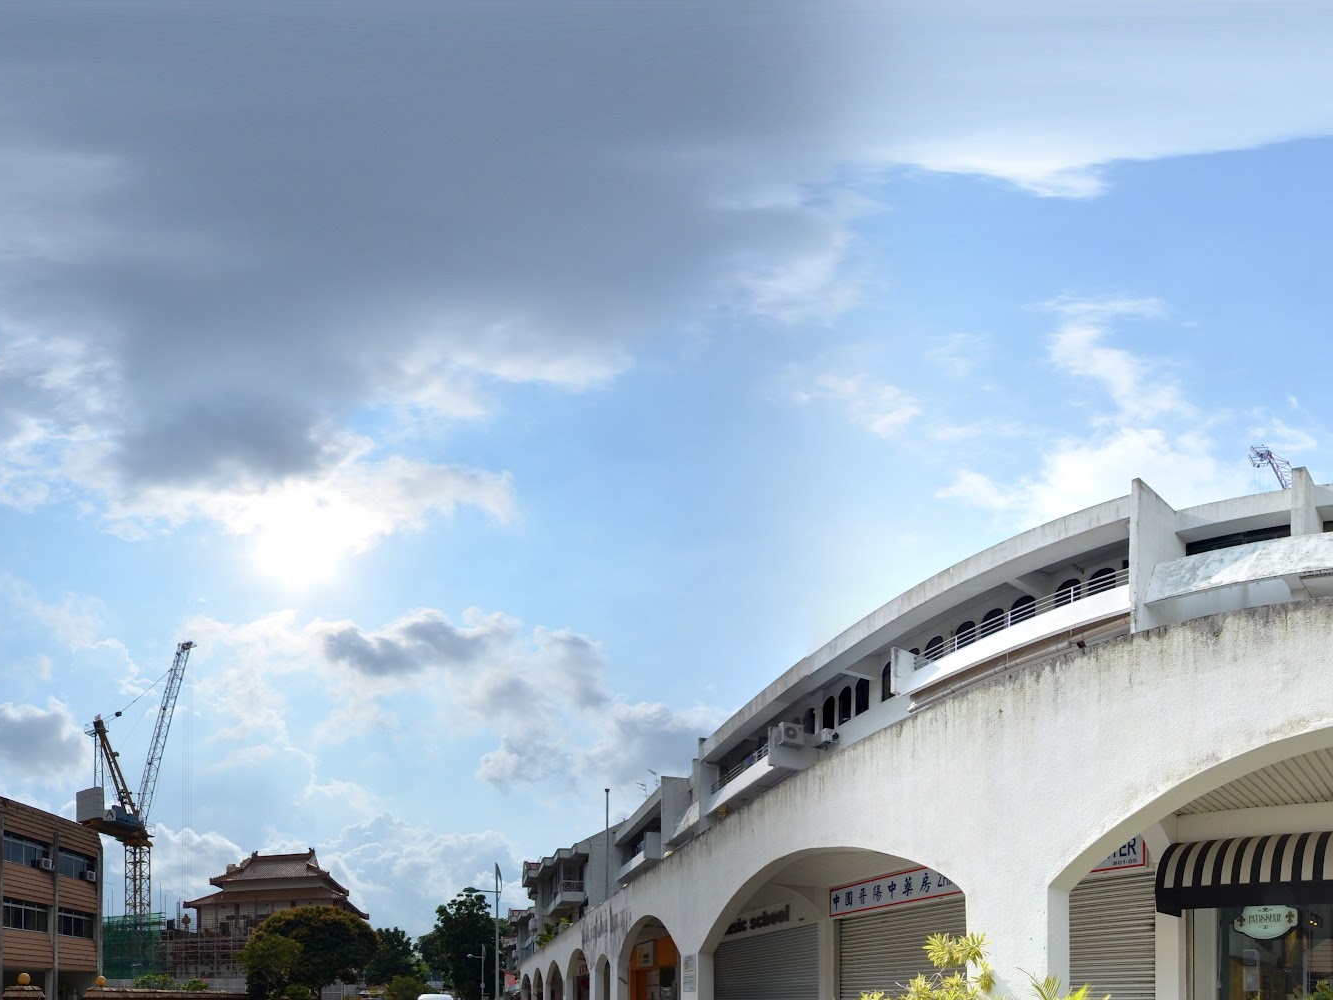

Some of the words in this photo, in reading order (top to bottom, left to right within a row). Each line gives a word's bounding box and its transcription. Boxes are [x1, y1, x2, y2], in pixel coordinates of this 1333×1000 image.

[1113, 858, 1138, 866] #01-05
[749, 904, 790, 930] school
[1248, 913, 1282, 924] PATISSERIE
